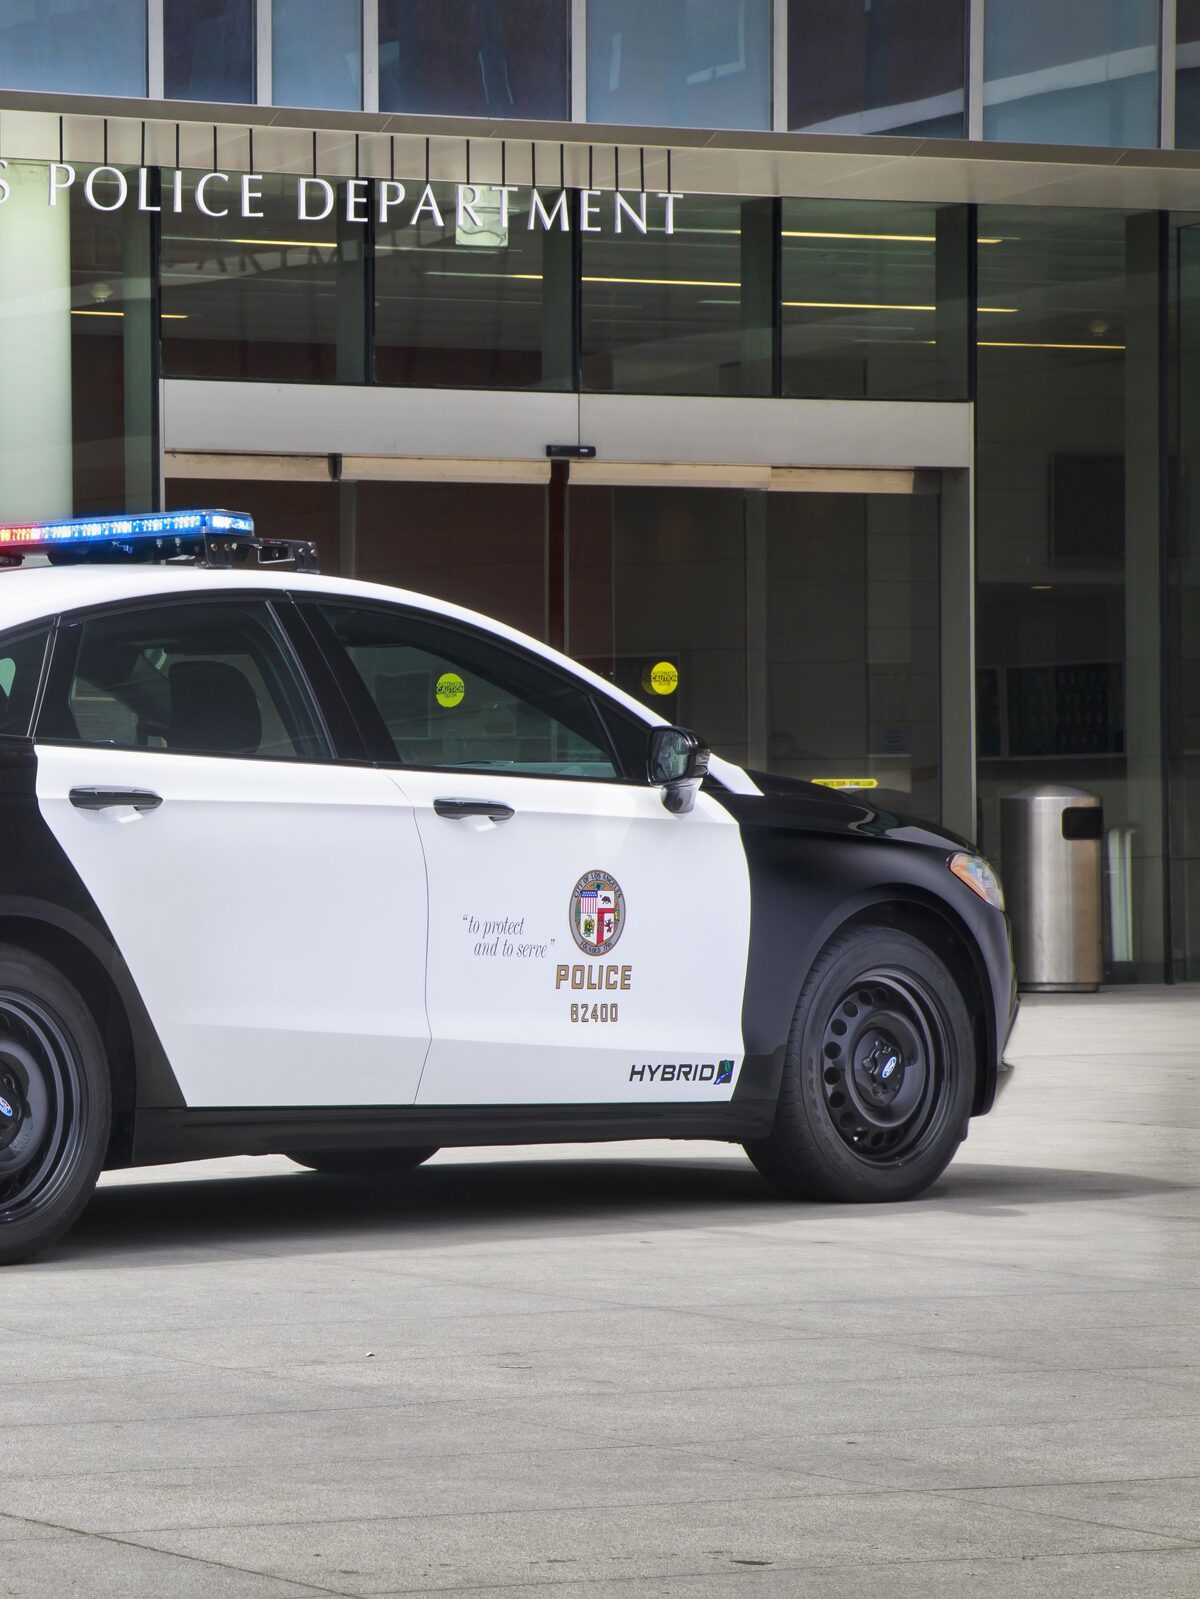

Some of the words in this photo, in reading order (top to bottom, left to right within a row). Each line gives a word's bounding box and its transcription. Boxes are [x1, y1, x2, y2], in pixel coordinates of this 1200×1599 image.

[48, 163, 264, 218] POLICE
[297, 177, 684, 235] DEPARTMENT
[437, 686, 465, 694] CAUTION
[591, 872, 601, 880] LOS
[483, 916, 525, 939] protect
[474, 936, 500, 957] and
[502, 939, 514, 957] to
[555, 964, 632, 990] POLICE
[570, 1003, 619, 1023] 82400
[629, 1064, 715, 1082] HYBRID
